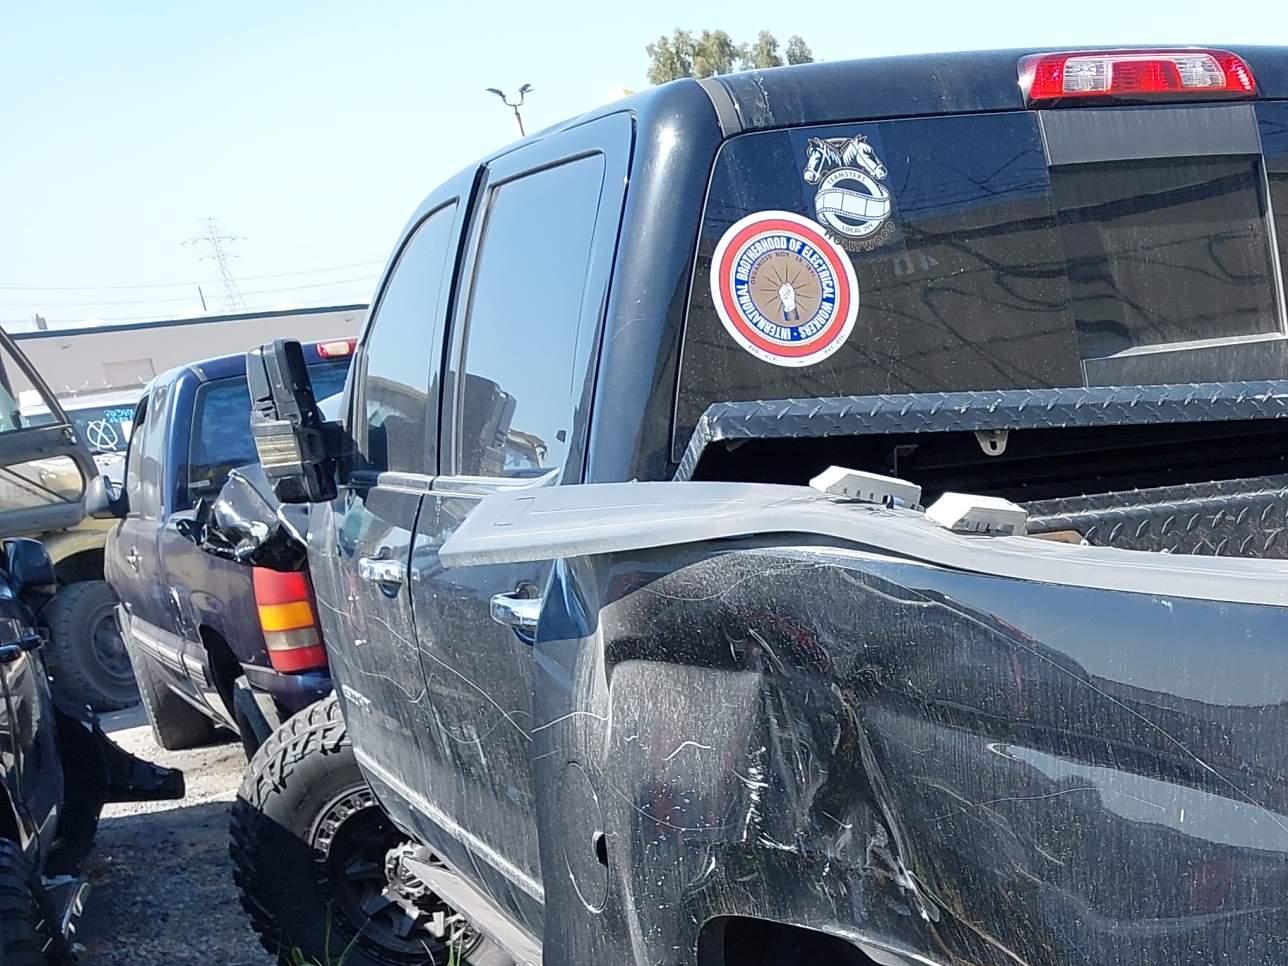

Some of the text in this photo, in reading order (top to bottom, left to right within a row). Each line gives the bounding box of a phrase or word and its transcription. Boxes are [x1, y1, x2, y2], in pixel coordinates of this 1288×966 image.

[827, 171, 866, 185] TEAMSTERS
[824, 221, 896, 252] HOLLYWOOD
[841, 225, 862, 234] LOCAL
[736, 236, 836, 340] INTERNATIONAL BROTHERHOOD OF ELECTRICAL WORKERS
